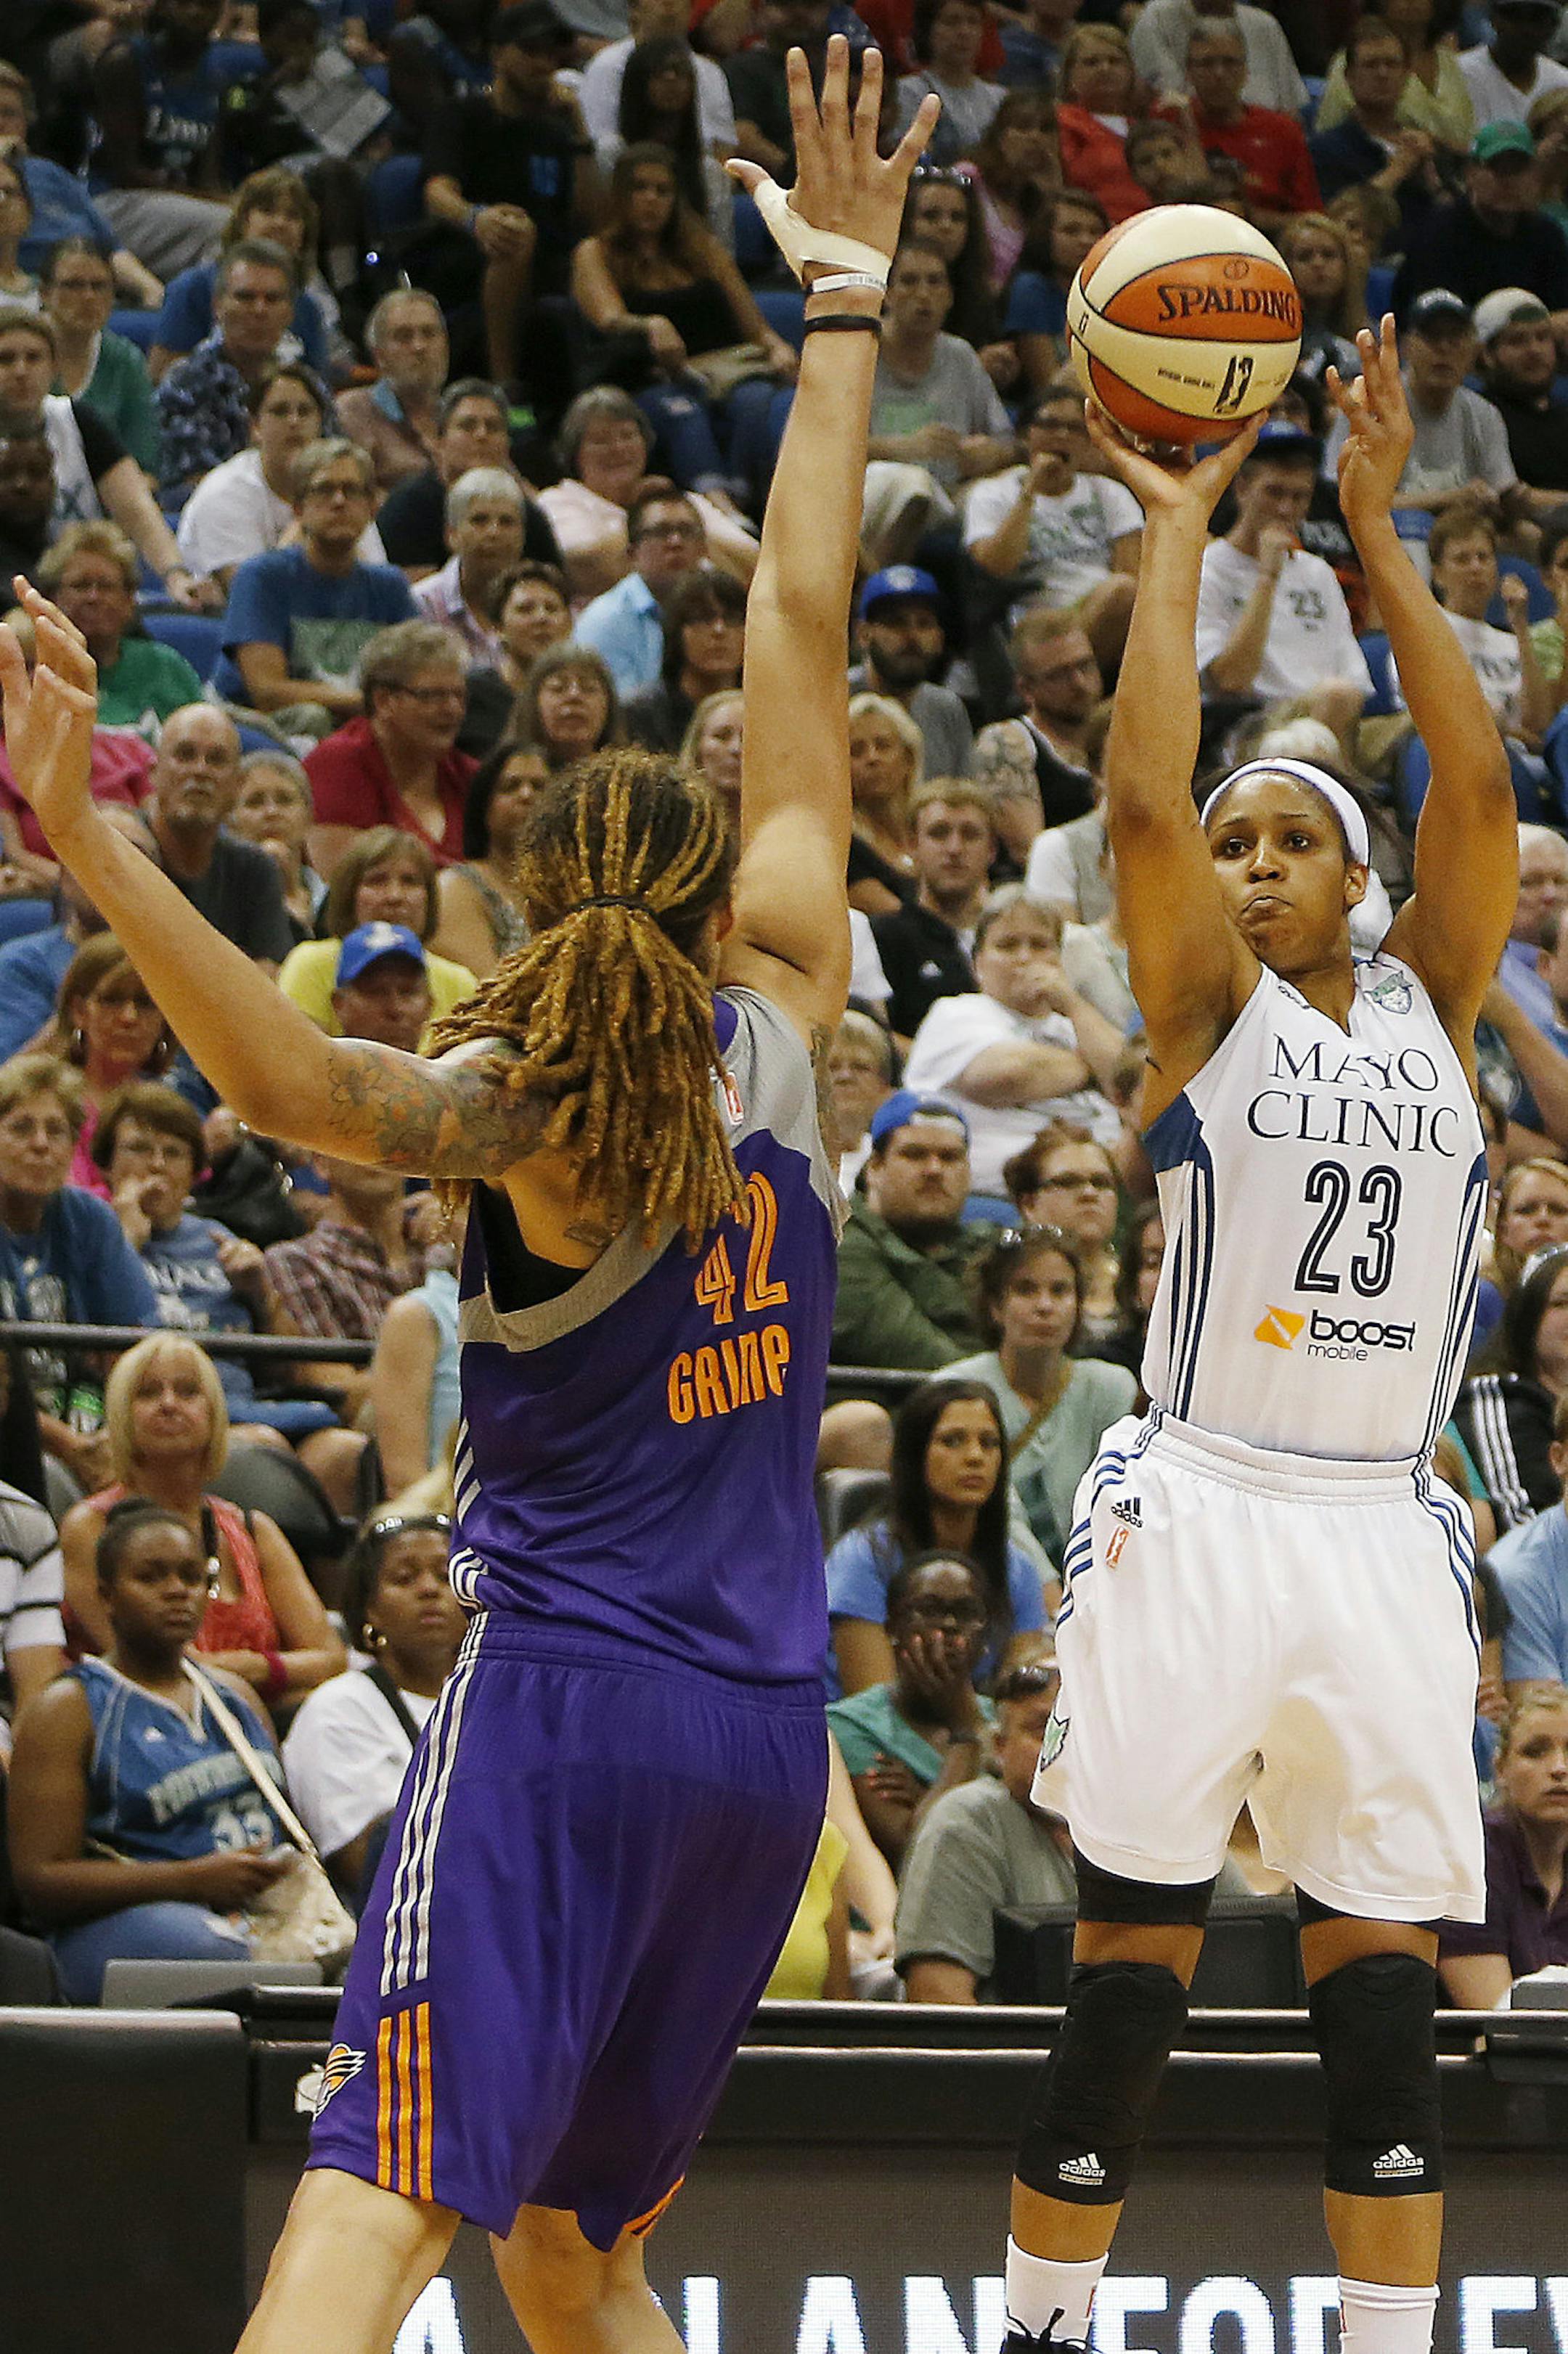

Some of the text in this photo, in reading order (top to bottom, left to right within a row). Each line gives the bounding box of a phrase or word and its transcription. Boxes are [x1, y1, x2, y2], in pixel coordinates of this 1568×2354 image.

[1156, 285, 1296, 329] SPALDING
[1269, 1033, 1440, 1092] MAYO
[1246, 1090, 1458, 1157] CLINIC
[694, 1171, 789, 1325] 42
[1294, 1160, 1402, 1298] 23
[1309, 1309, 1416, 1352] boost
[1307, 1344, 1368, 1362] mobile
[1111, 1506, 1143, 1528] adidas
[1058, 2163, 1106, 2178] adidas
[1373, 2157, 1424, 2169] adidas
